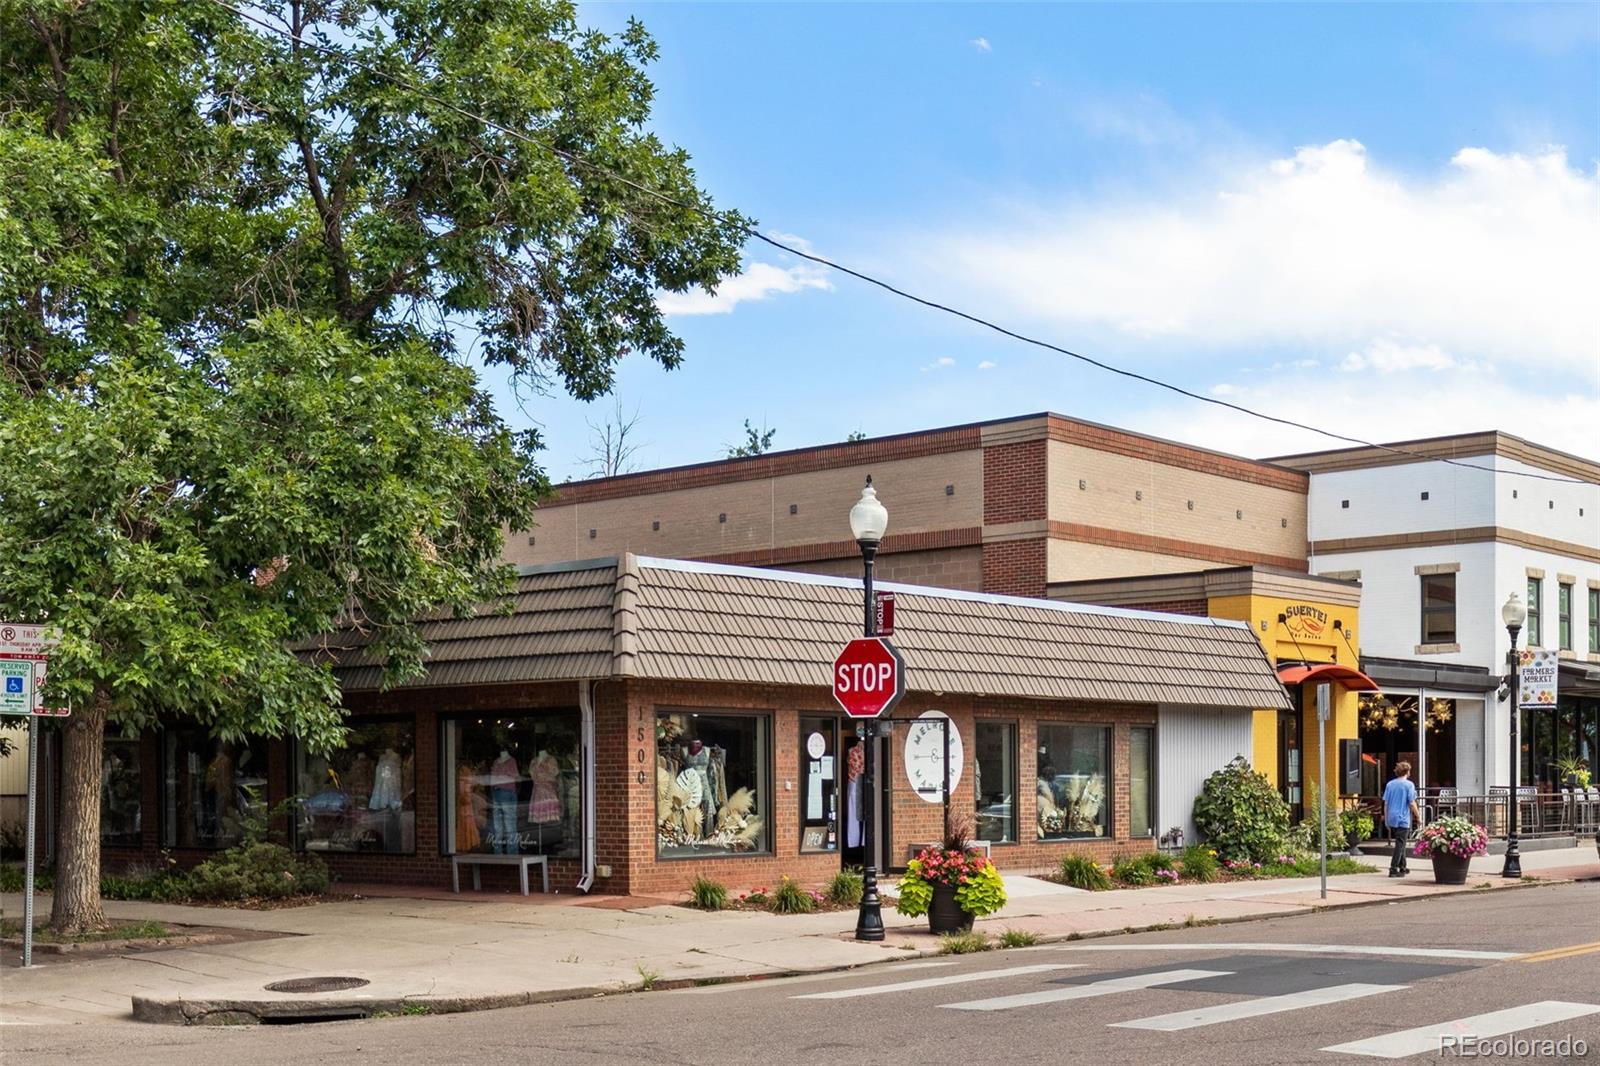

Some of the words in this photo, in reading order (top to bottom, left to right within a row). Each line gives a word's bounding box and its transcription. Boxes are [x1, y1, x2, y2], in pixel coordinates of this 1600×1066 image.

[1286, 605, 1327, 624] SUERTE!
[838, 663, 892, 693] STOP
[1522, 668, 1556, 676] FARMERS
[1524, 676, 1553, 684] MARKET
[914, 723, 956, 745] MELROE
[637, 706, 645, 784] 1500
